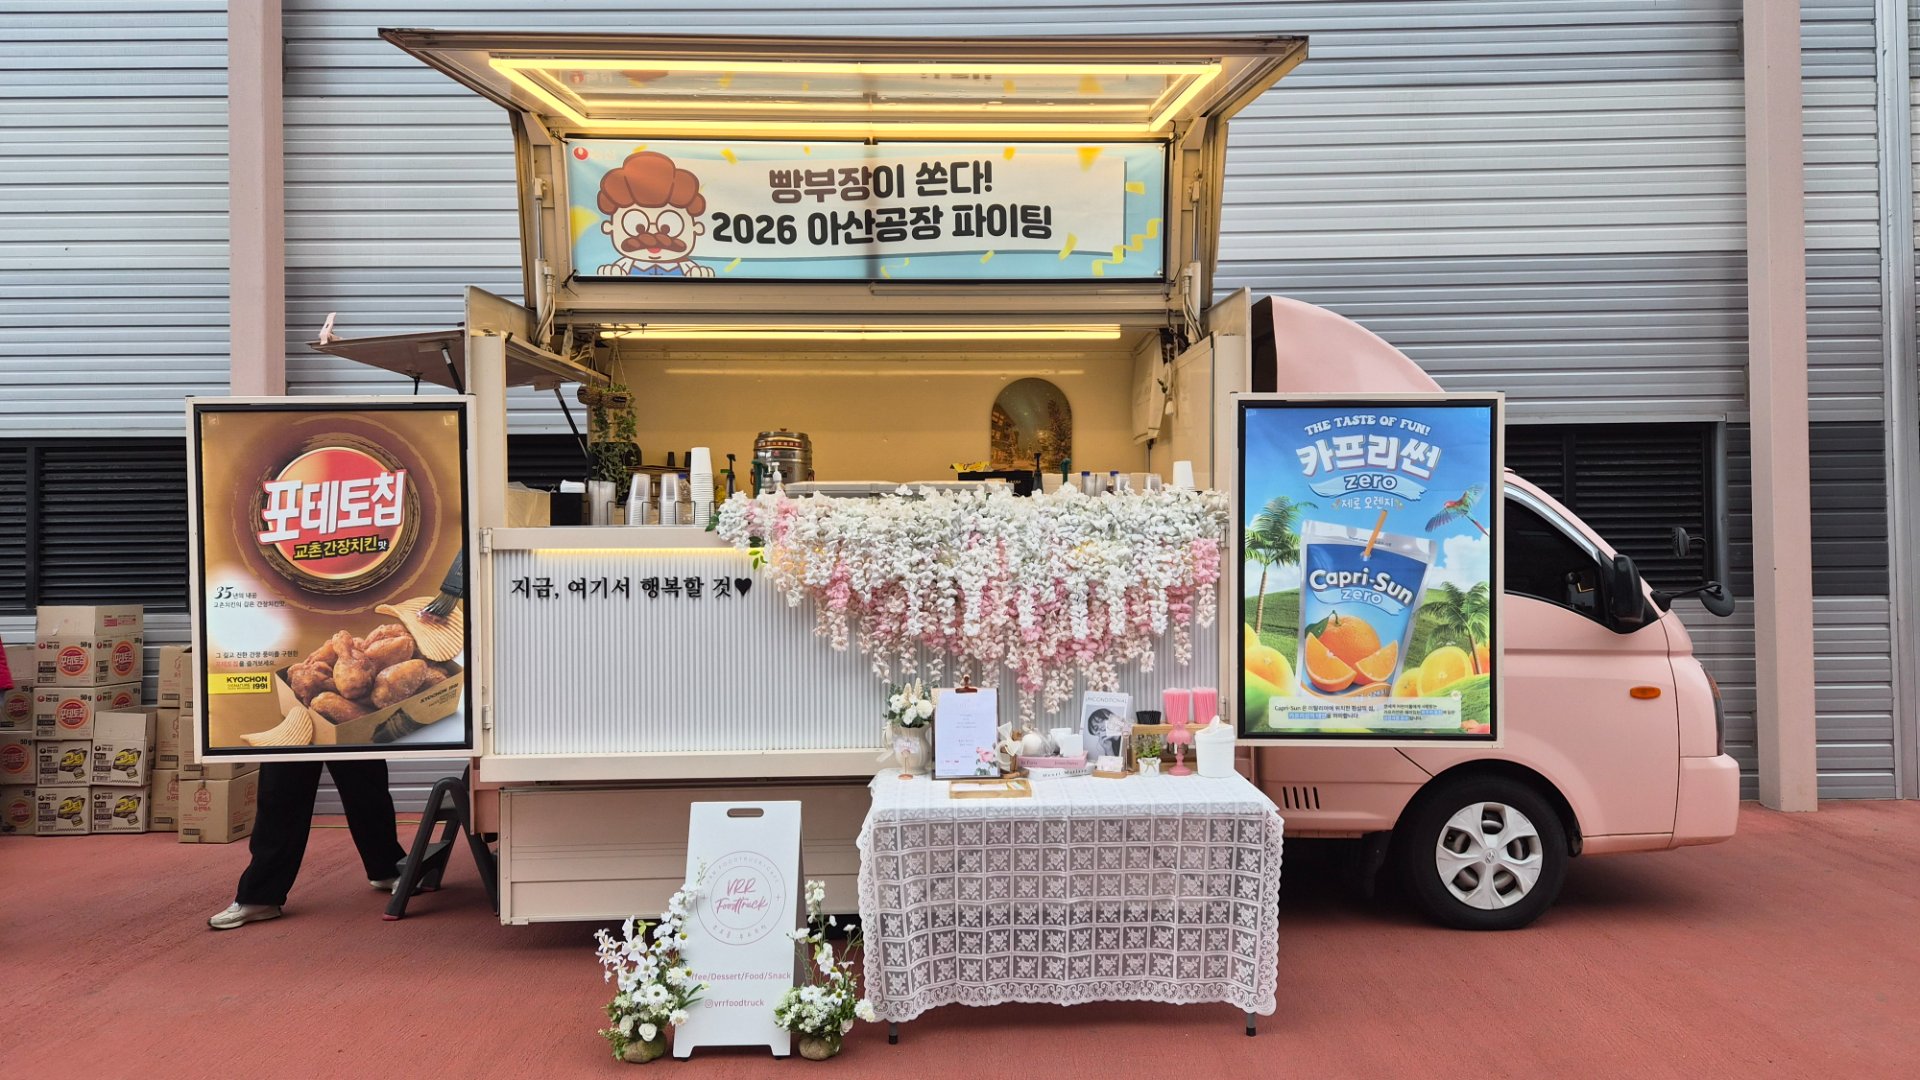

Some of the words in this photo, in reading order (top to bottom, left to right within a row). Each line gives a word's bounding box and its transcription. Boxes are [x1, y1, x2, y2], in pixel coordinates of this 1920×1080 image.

[769, 164, 904, 204] 빵부장이
[916, 160, 993, 197] 쏜다!
[711, 211, 797, 245] 2026
[808, 205, 944, 245] 아산공장
[952, 203, 1052, 239] 파이팅
[1304, 419, 1331, 436] THE
[1334, 415, 1377, 428] TASTE
[1379, 415, 1398, 427] OF
[1400, 418, 1432, 436] FUN!
[1295, 433, 1442, 480] 카프리썬
[1343, 473, 1398, 491] zero
[258, 470, 406, 545] 포테토칩
[1341, 497, 1362, 510] 제로
[1364, 496, 1394, 510] 오렌지
[294, 541, 322, 560] 교촌
[511, 576, 560, 600] 지금,
[567, 577, 630, 599] 여기서
[640, 576, 704, 599] 행복할
[1309, 567, 1414, 605] Capri-Sun
[1341, 588, 1383, 605] zero
[727, 877, 757, 897] VRR
